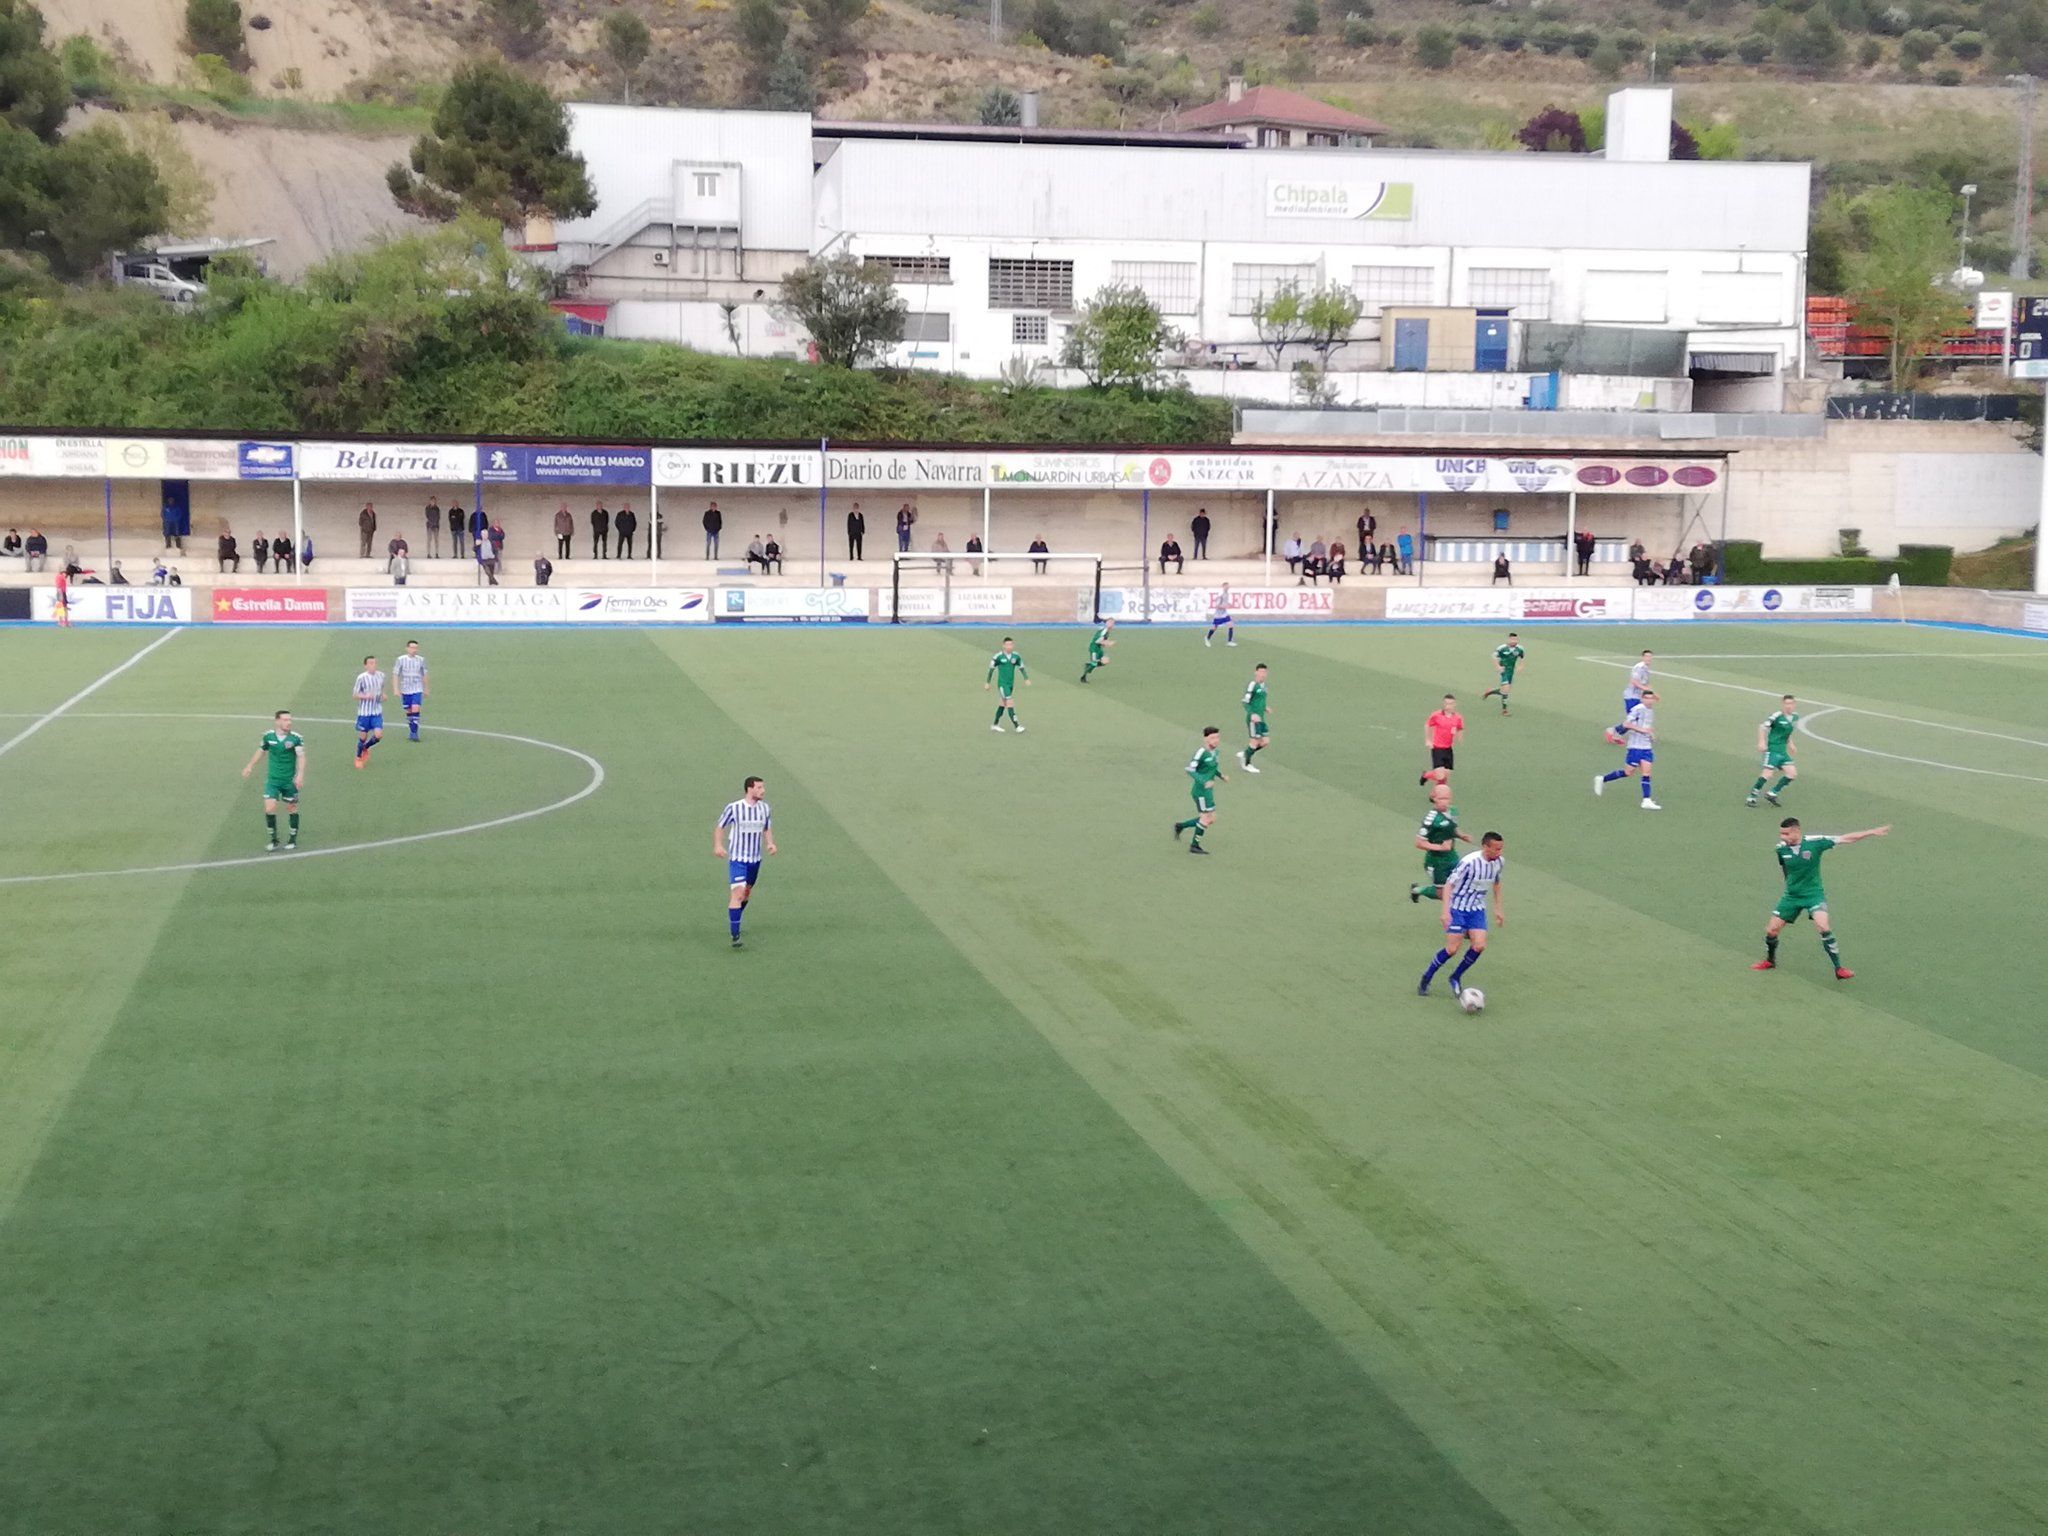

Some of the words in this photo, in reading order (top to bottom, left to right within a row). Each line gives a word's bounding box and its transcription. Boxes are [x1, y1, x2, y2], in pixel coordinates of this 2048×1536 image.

[1273, 184, 1348, 207] Chipala
[535, 454, 607, 467] AUTOMÓVILES
[608, 456, 645, 468] MARCO
[829, 458, 882, 480] Diario
[887, 458, 907, 480] de
[915, 459, 982, 481] Navarra
[702, 462, 812, 484] RIEZU
[1296, 471, 1394, 488] AZANZA
[105, 595, 178, 620] FIJA
[232, 598, 282, 611] Estrella
[284, 598, 325, 611] Damm
[404, 593, 561, 606] ASTARRIAGA
[1208, 592, 1288, 609] EECTRO
[1299, 592, 1331, 609] PAX
